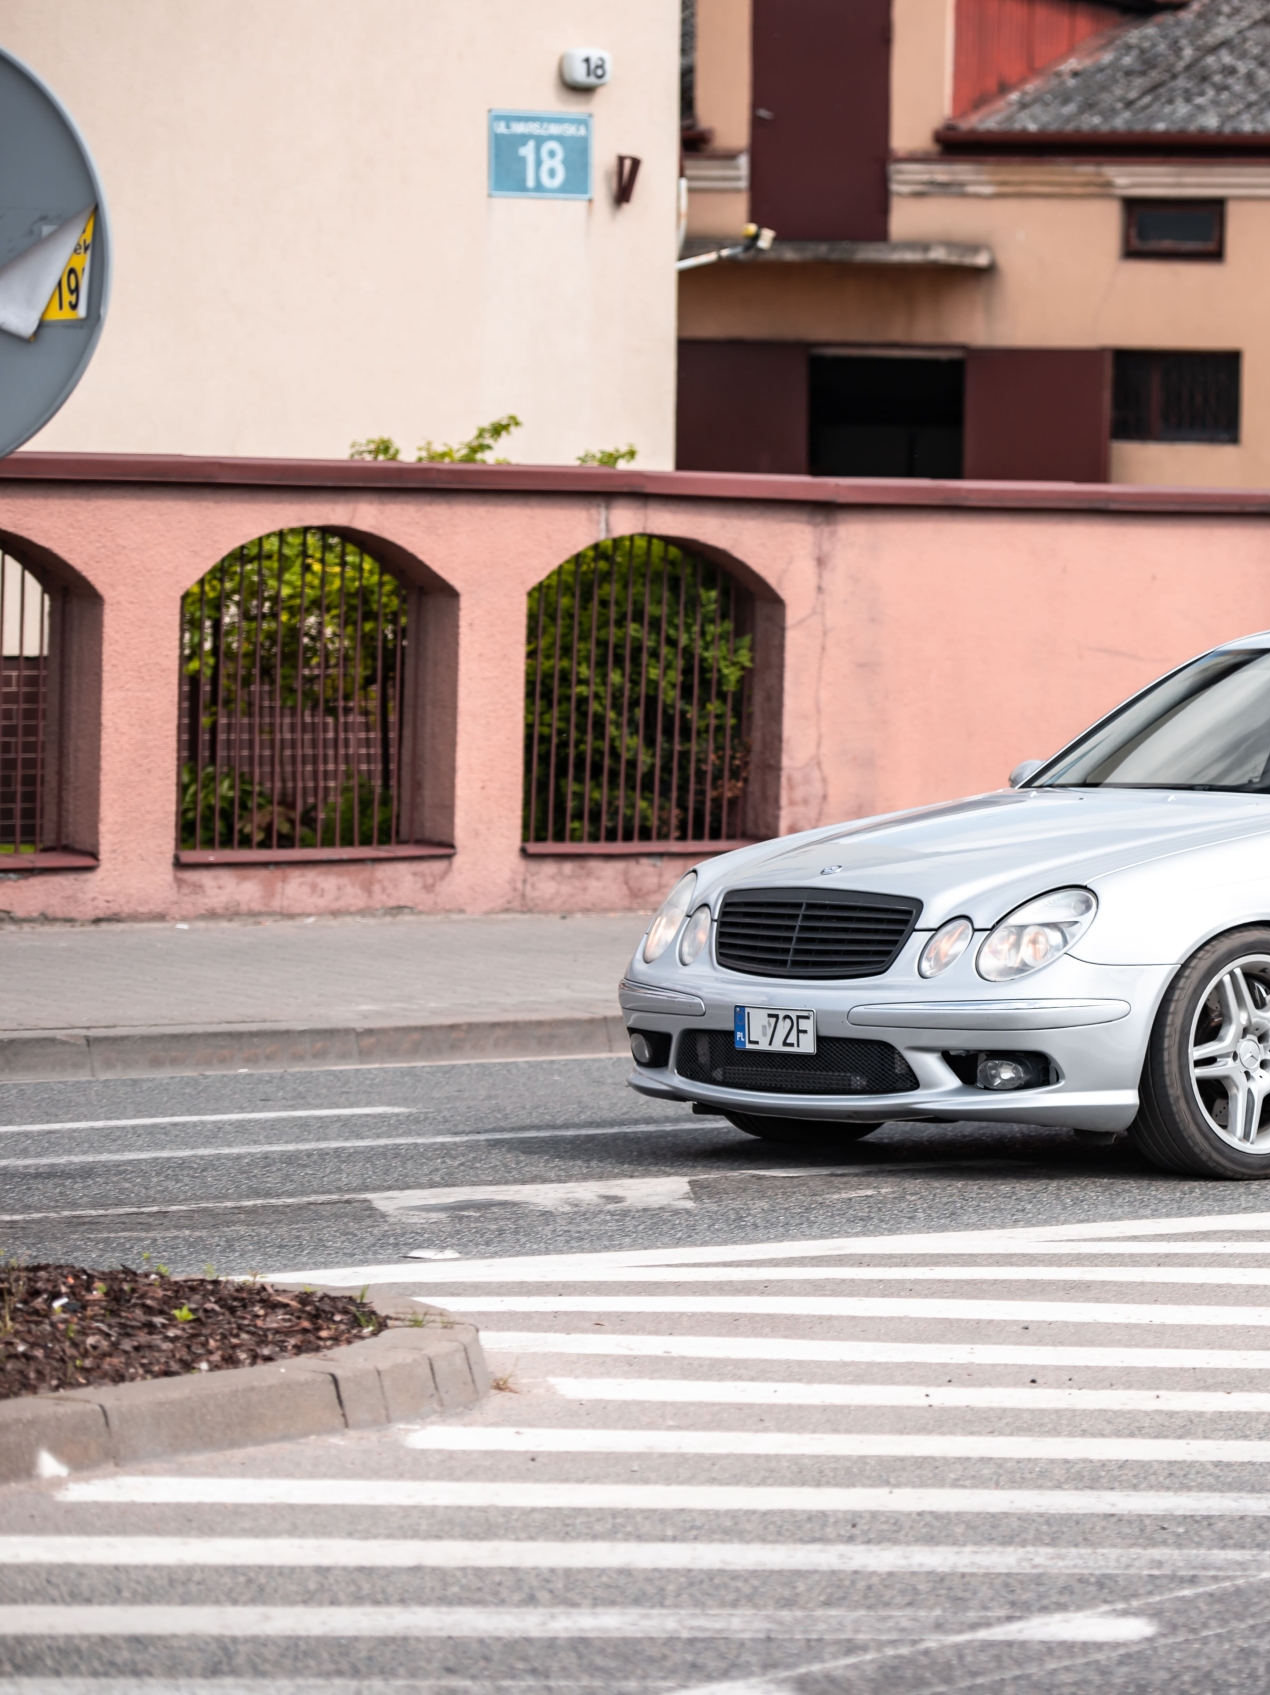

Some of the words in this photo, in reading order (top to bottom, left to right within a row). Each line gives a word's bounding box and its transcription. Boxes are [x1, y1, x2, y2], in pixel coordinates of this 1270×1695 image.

[582, 56, 606, 79] 18
[518, 139, 566, 189] 18
[736, 1031, 745, 1042] PL
